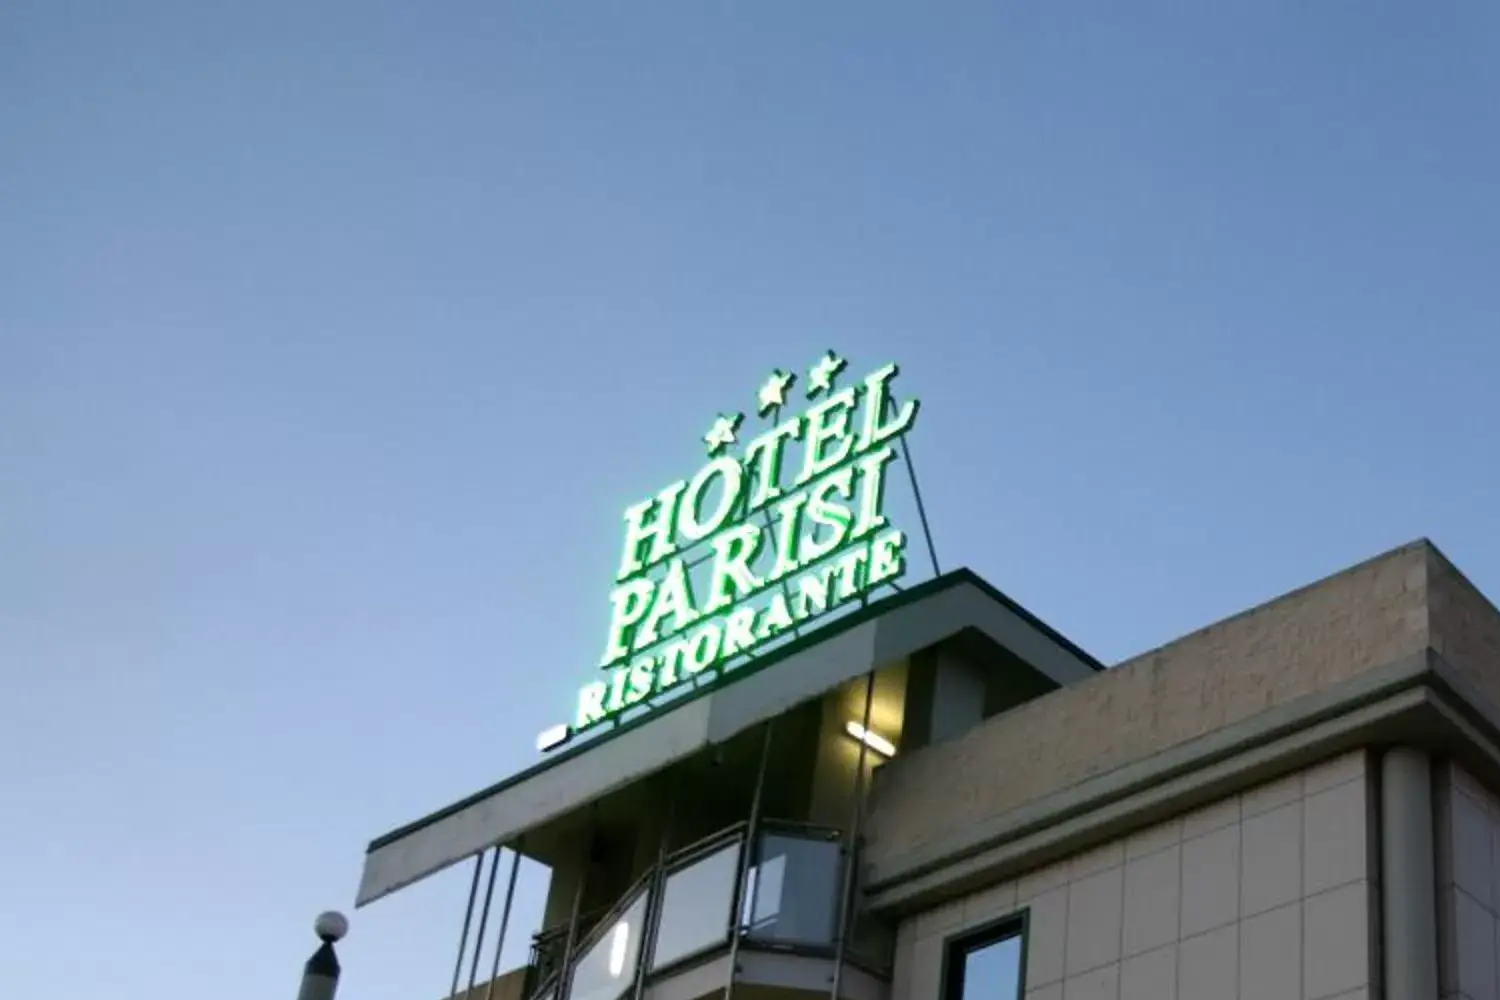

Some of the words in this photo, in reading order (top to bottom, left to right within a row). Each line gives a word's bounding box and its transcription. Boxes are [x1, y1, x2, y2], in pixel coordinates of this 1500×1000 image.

[602, 448, 896, 668] PARISI
[618, 363, 919, 581] HOTEL
[575, 530, 905, 730] RISTORANTE
